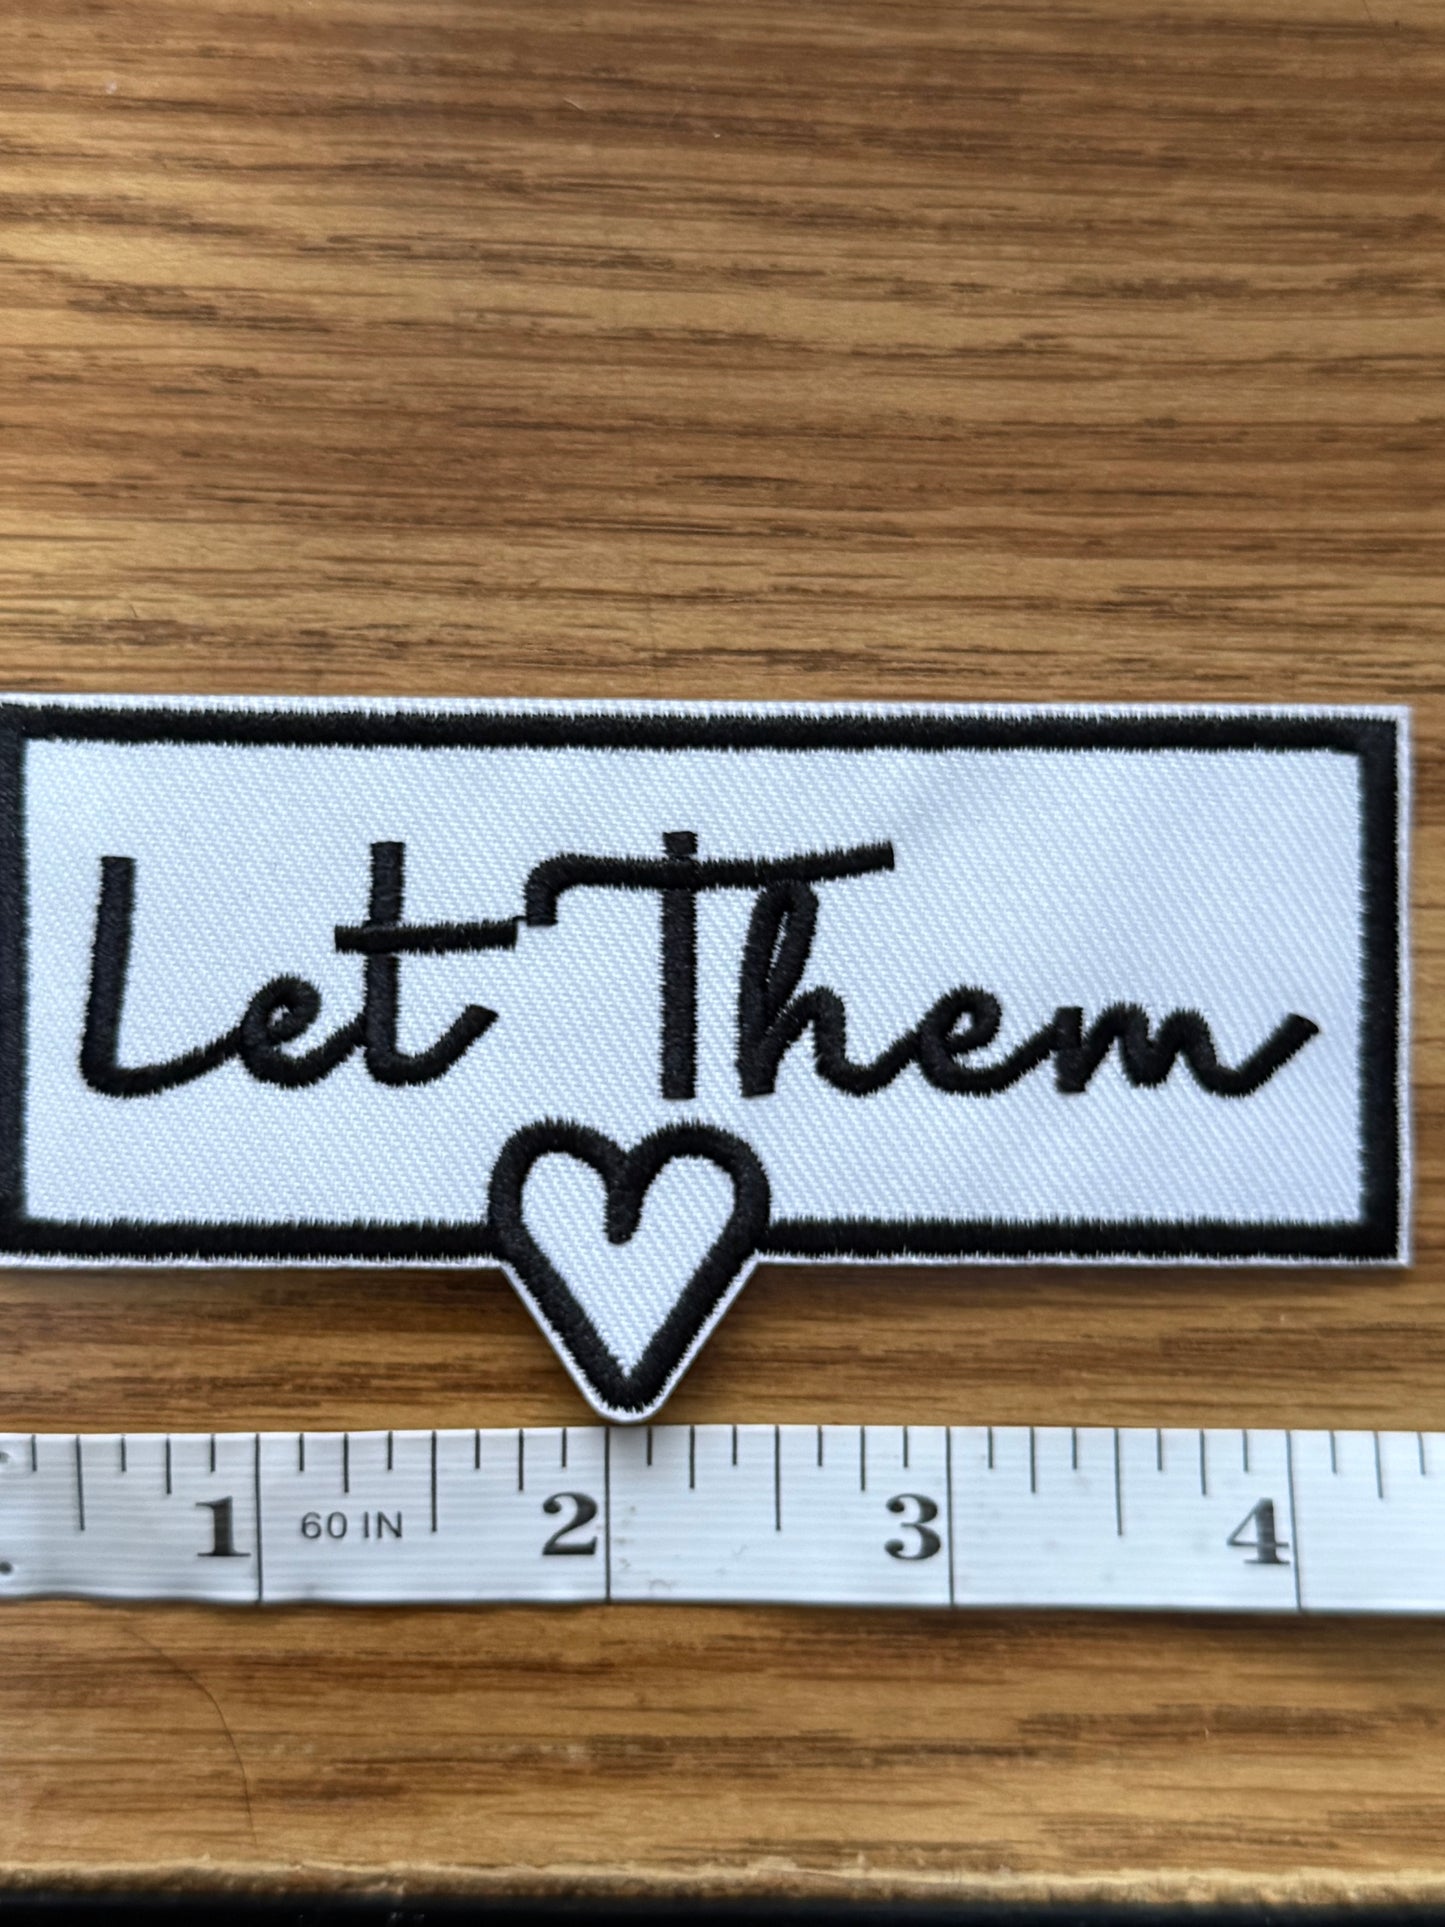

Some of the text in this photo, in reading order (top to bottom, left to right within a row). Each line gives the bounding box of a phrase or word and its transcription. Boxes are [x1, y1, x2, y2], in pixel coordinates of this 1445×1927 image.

[79, 831, 1320, 1100] Let Them
[195, 1496, 251, 1558] 1
[301, 1511, 403, 1540] 60 IN
[541, 1492, 598, 1557] 2
[884, 1493, 941, 1561] 3
[1226, 1497, 1290, 1566] 4
